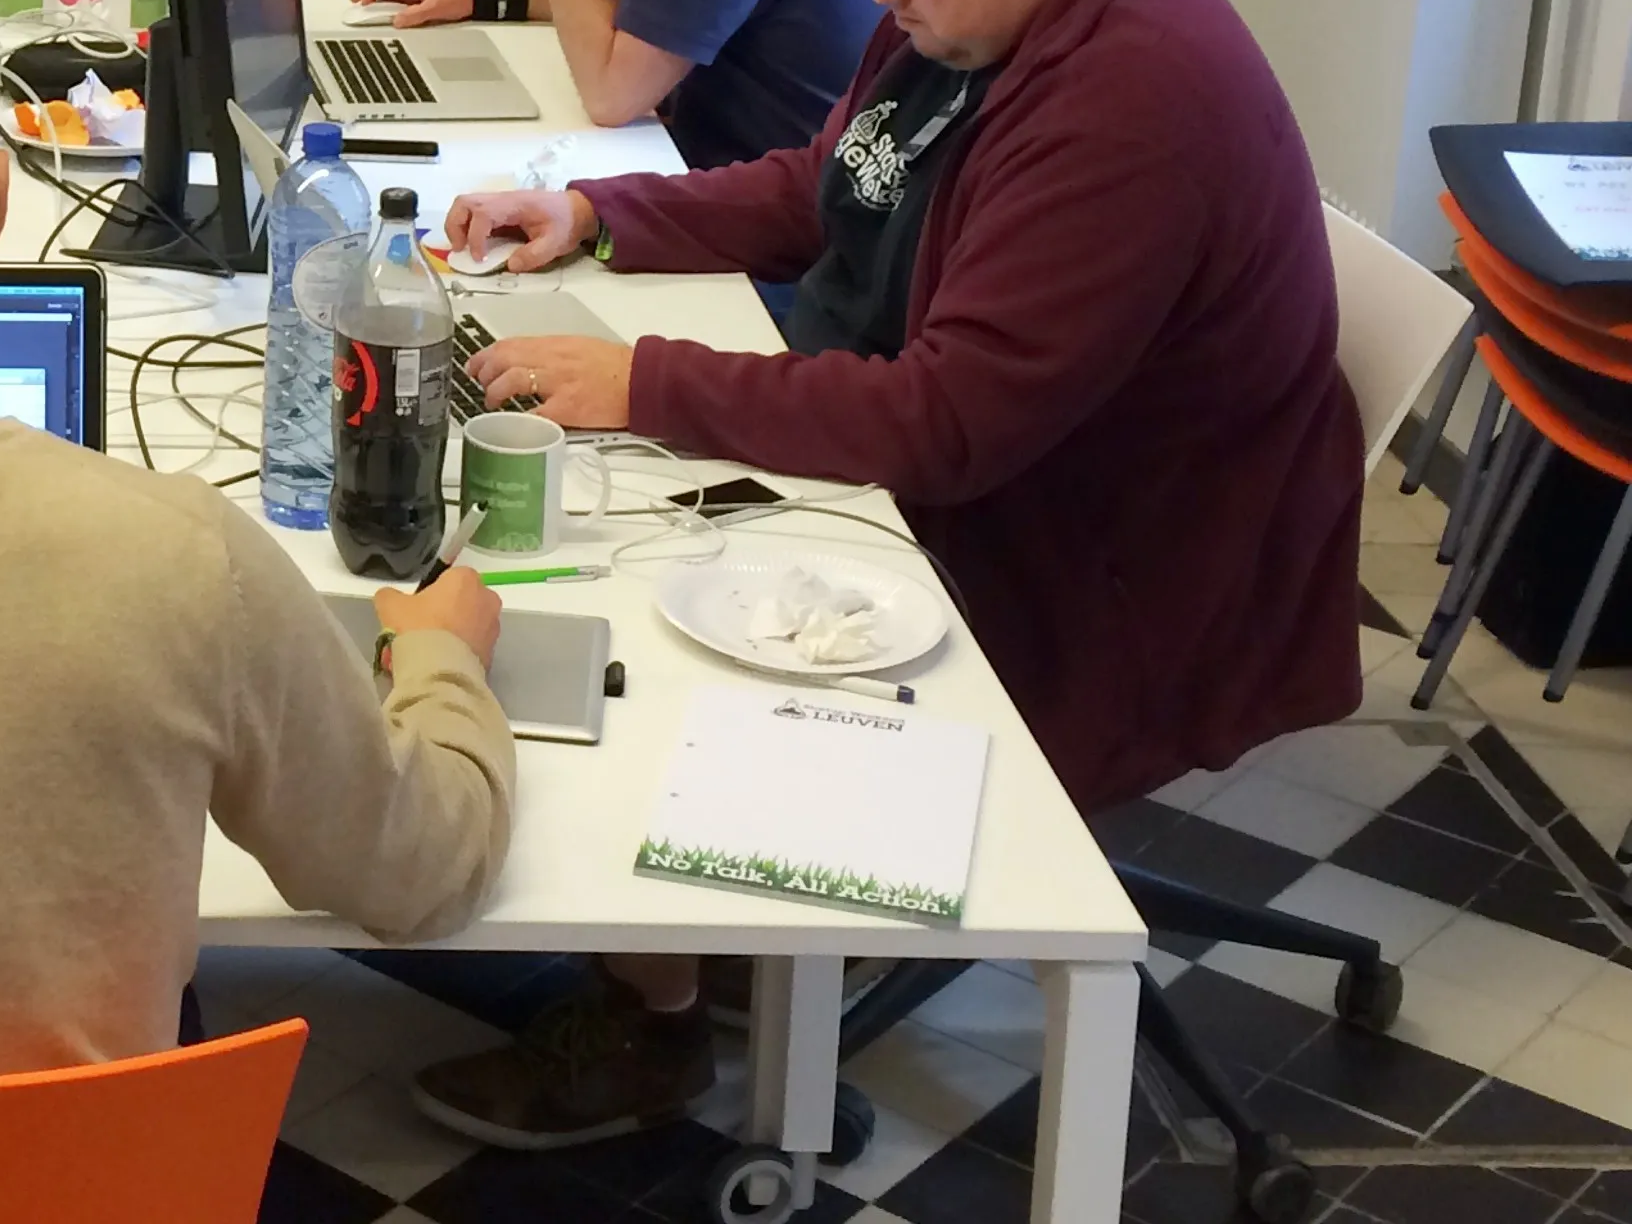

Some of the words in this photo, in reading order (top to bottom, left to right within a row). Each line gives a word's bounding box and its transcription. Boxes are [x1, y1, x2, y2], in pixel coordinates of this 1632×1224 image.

[813, 711, 903, 732] LEUVEN
[647, 851, 692, 871] No
[702, 860, 774, 887] Talk.
[784, 876, 829, 895] All
[838, 887, 950, 915] Action.
